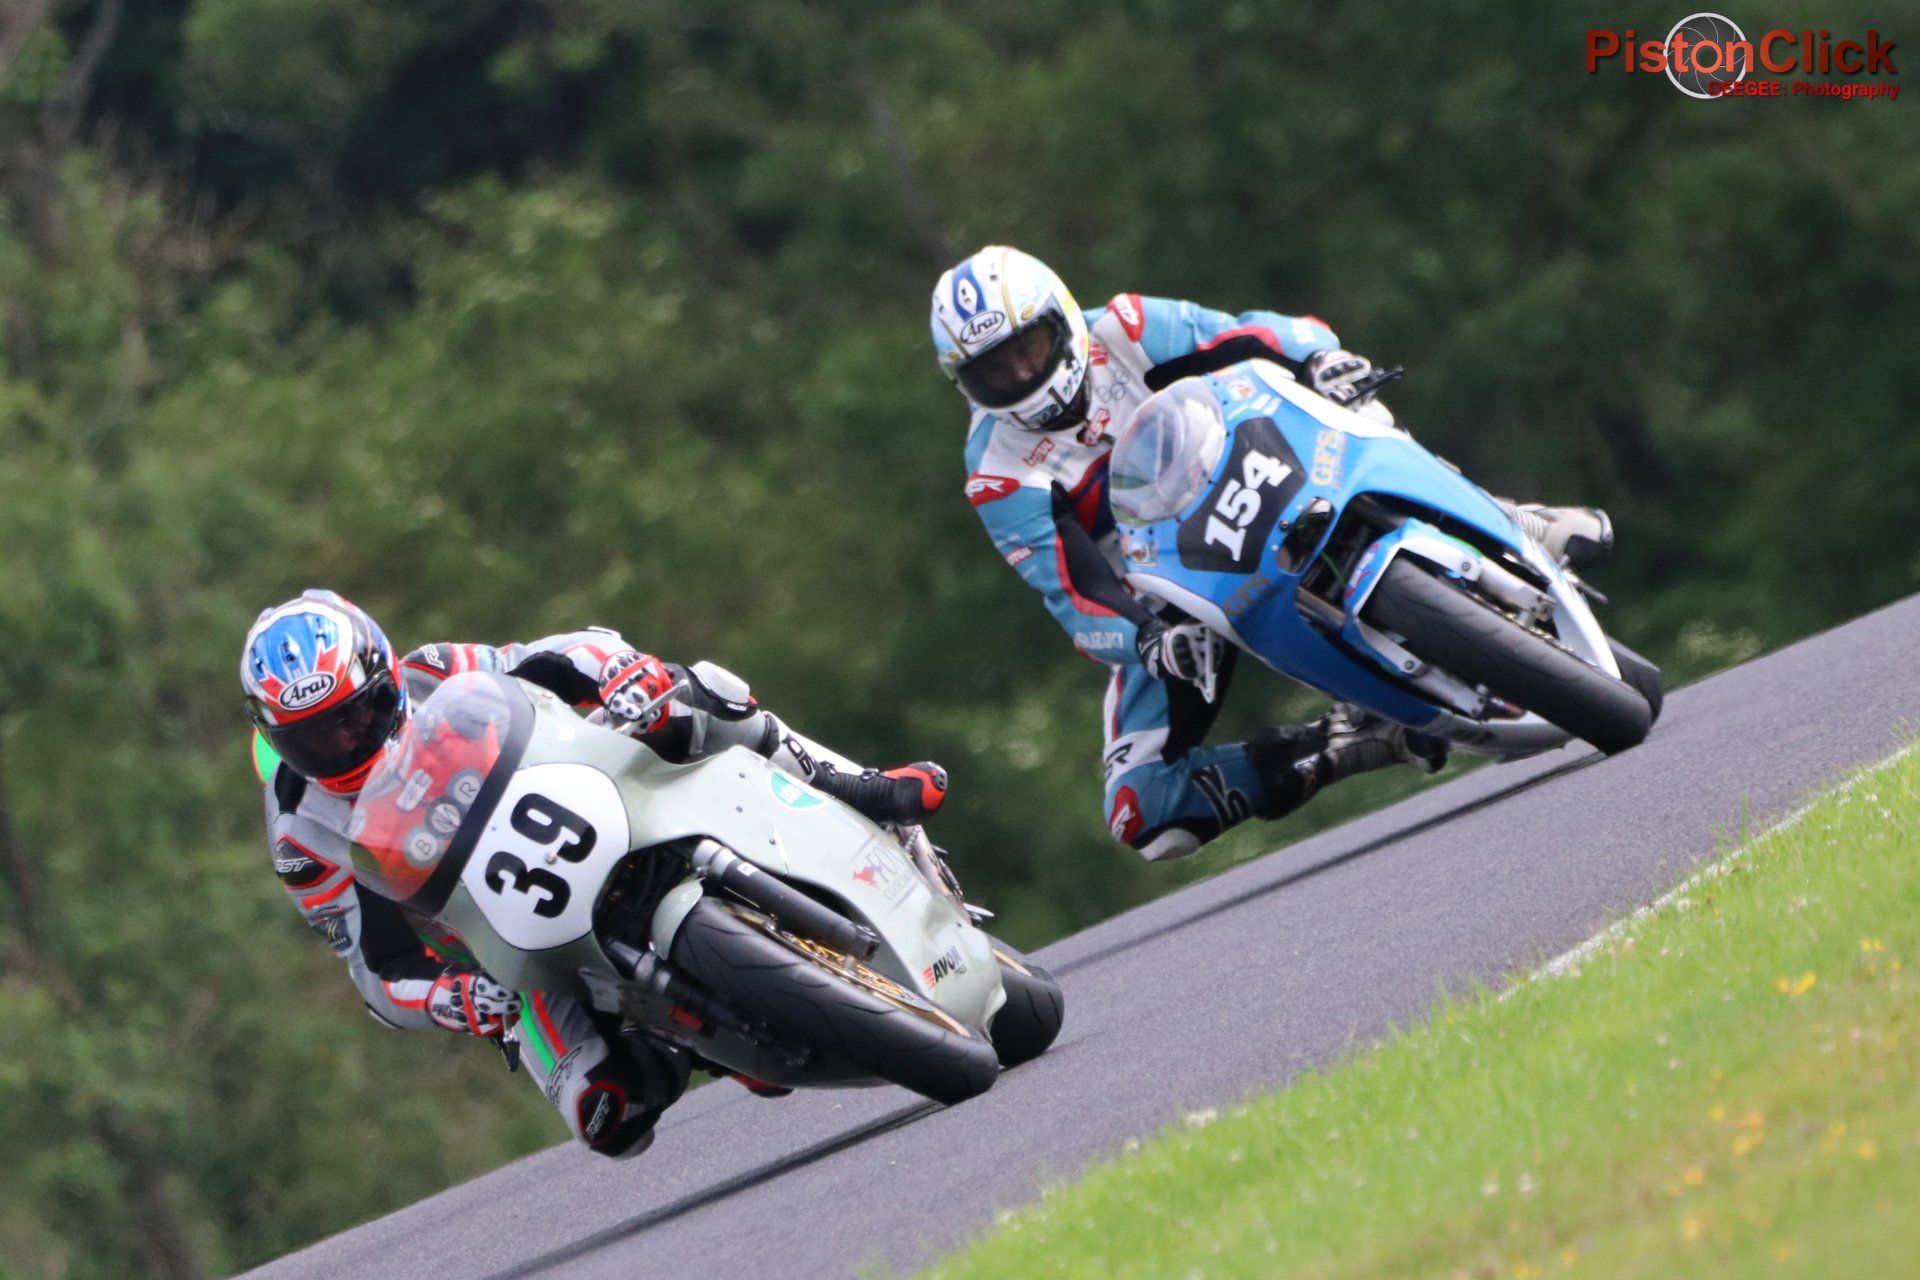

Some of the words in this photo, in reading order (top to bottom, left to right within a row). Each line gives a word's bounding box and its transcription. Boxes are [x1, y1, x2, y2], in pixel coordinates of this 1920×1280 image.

[967, 313, 998, 338] Arai
[1204, 449, 1293, 562] 154
[286, 675, 328, 704] Arai
[485, 793, 598, 918] 39
